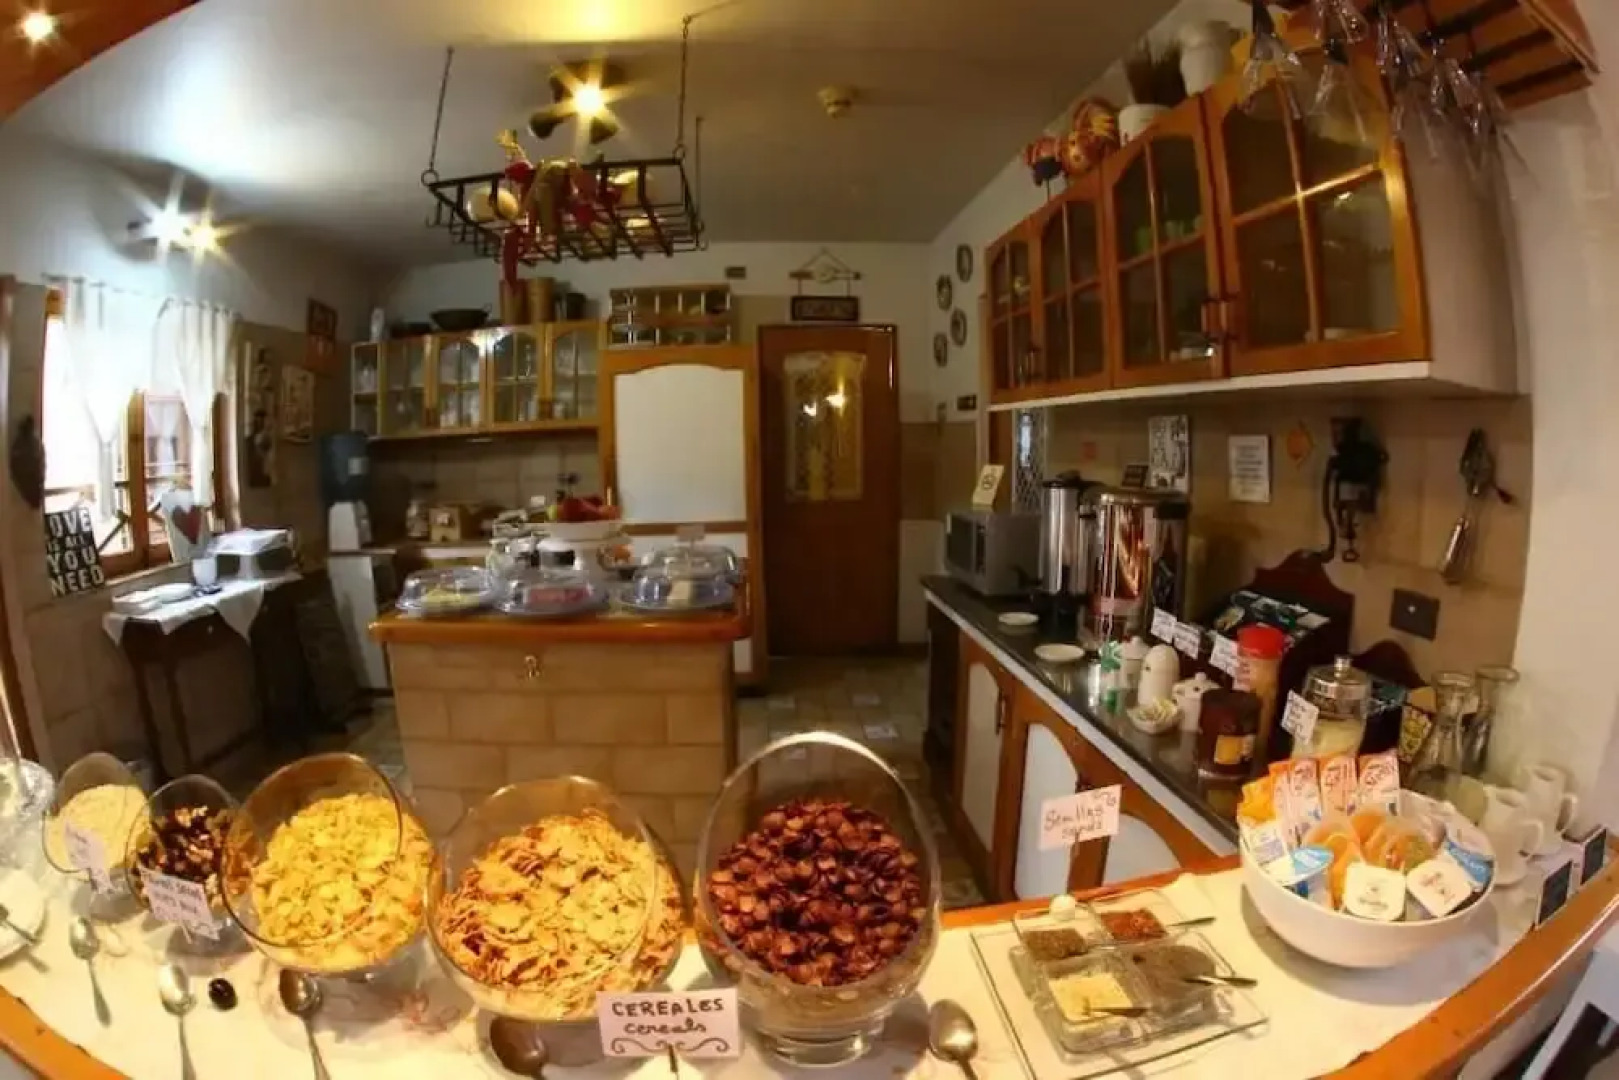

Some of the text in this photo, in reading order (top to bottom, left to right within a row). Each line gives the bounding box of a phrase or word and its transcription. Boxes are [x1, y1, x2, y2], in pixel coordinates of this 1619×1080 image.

[47, 508, 92, 538] OVE
[46, 545, 96, 574] YOU
[48, 564, 105, 597] NEED
[611, 998, 725, 1017] CEREALES
[624, 1017, 706, 1035] cereals
